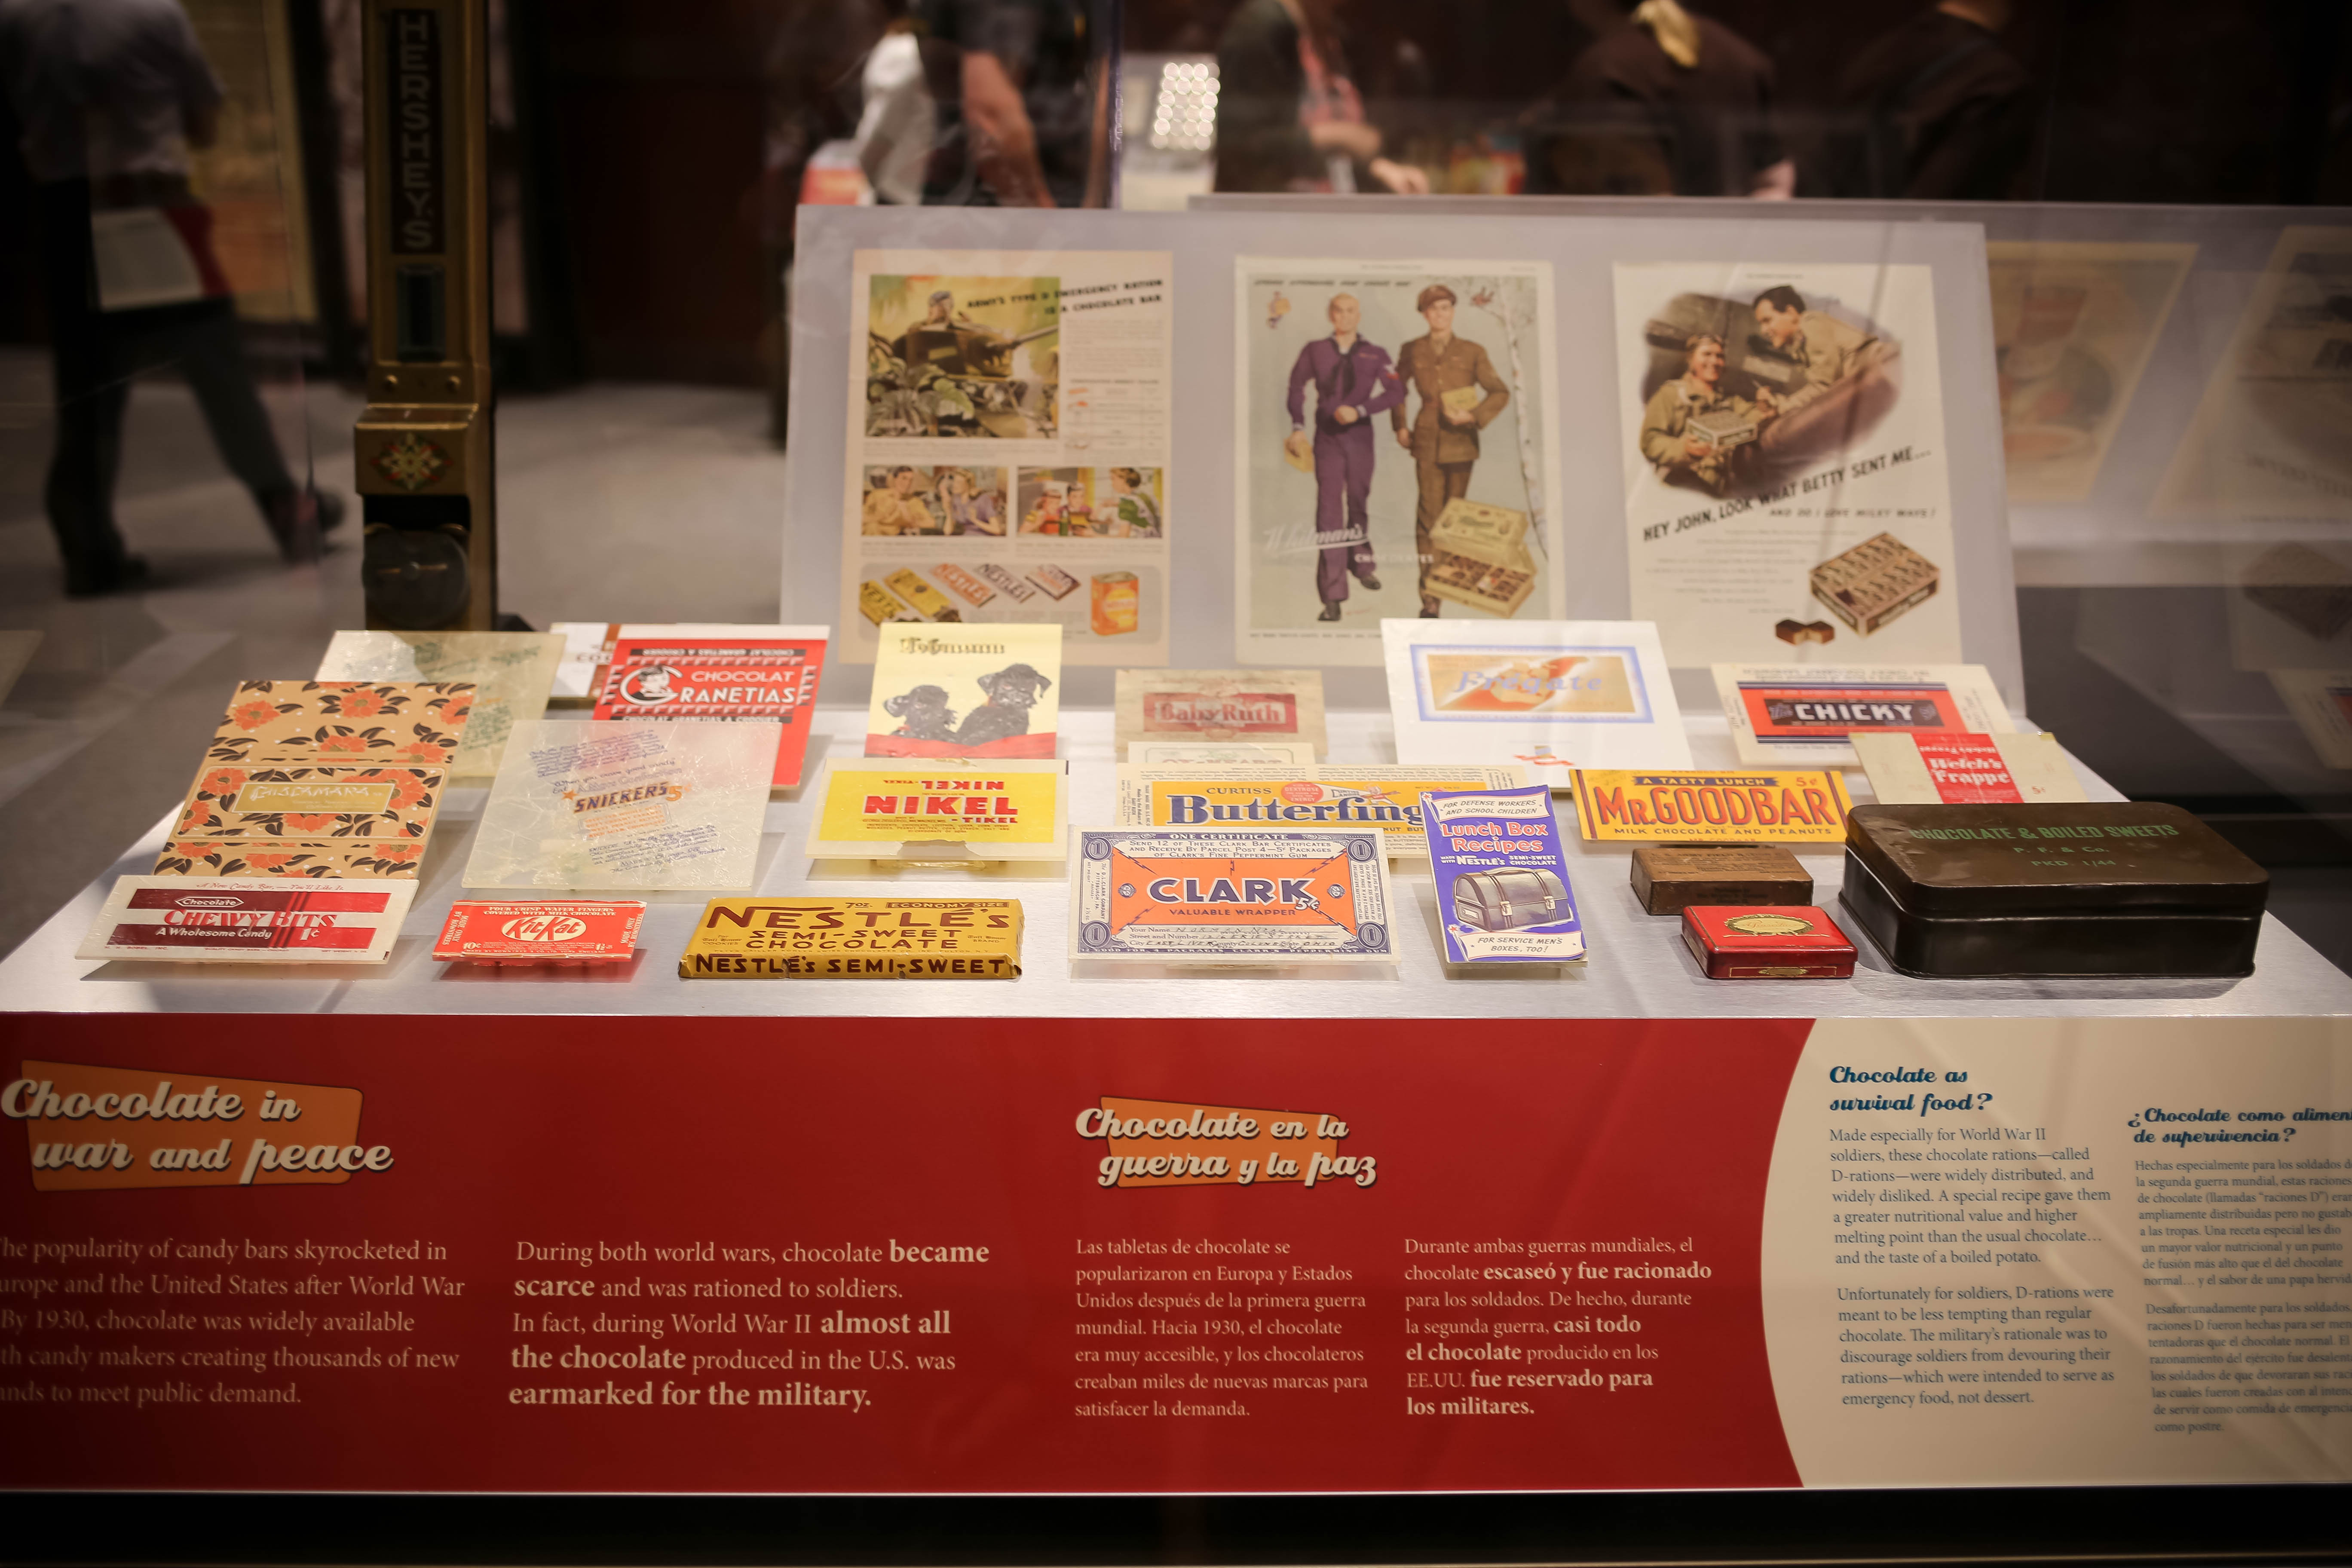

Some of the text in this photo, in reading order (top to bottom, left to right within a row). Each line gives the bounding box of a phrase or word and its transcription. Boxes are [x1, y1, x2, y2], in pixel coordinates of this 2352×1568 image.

[1643, 521, 1670, 542] HEY
[1675, 509, 1716, 533] JOHN,
[1718, 497, 1753, 519] LOOK
[1758, 478, 1798, 506] WHAT
[1803, 469, 1845, 495] BETTY
[1851, 455, 1887, 479] SENT
[691, 671, 795, 683] CHOCOLAT
[1222, 704, 1280, 722] Ruth
[1794, 703, 1913, 722] CHICKY
[1928, 757, 2003, 770] Welch's
[573, 781, 669, 814] SNICKERS
[1207, 787, 1272, 798] CURTISS
[863, 794, 1020, 816] NIKEL
[1165, 793, 1422, 826] Butterfing
[1441, 821, 1549, 837] Lunch Box
[1908, 825, 2180, 839] CHOCOLATE & BOILED SWEETS
[1451, 836, 1544, 854] Recipes
[1147, 877, 1318, 906] CLARK
[164, 909, 337, 927] CHEWY BITS
[169, 928, 236, 936] Wholesome
[237, 928, 272, 939] Candy
[748, 929, 962, 940] SEMI-SWEET
[746, 939, 959, 949] CHOCOLATE
[827, 959, 1004, 974] SEMI-SWEET
[1829, 1066, 1968, 1084] Chocolate as
[1, 1079, 302, 1120] Chocolate in
[1829, 1093, 1915, 1112] survival
[1075, 1108, 1350, 1139] Chocolate en la
[2237, 1112, 2286, 1123] como
[1829, 1127, 2047, 1145] Made especially for World War II
[2133, 1129, 2157, 1143] de
[32, 1138, 394, 1185] war and peace
[1098, 1152, 1377, 1187] guerra y la paz
[517, 1238, 989, 1268] During both world wars, chocolate became
[1076, 1265, 1353, 1286] popularizaron en Europa y Estados
[509, 1381, 872, 1414] earmarked for the military.
[1407, 1396, 1534, 1415] los militares.
